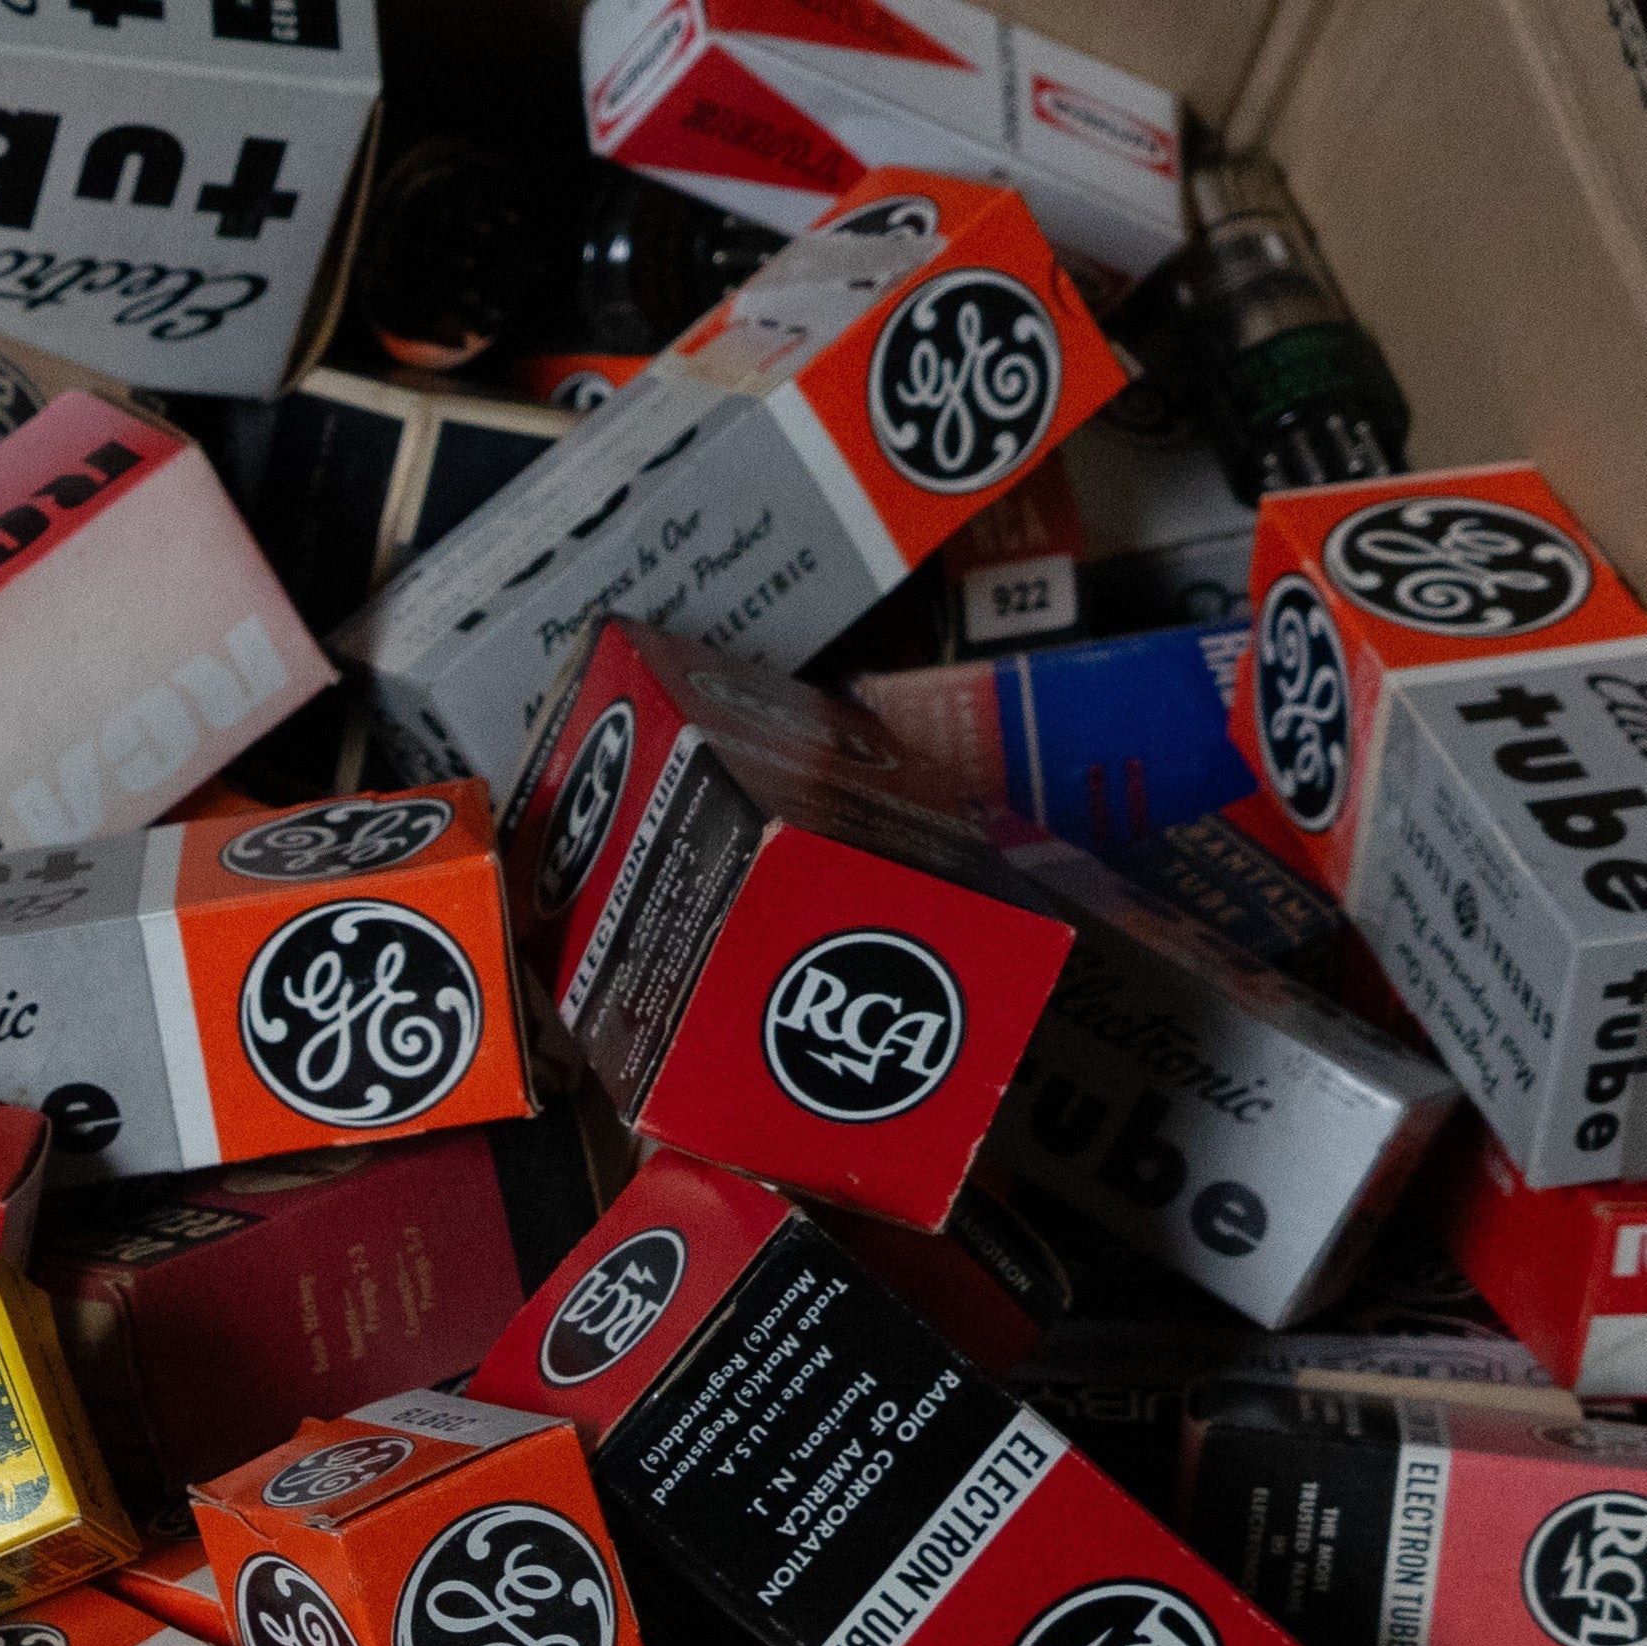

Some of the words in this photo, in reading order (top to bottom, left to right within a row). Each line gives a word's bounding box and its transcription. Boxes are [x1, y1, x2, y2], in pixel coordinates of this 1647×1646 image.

[663, 510, 699, 551] Our
[992, 578, 1051, 616] 922
[1457, 685, 1647, 914] tube
[567, 835, 650, 1017] ELECTRON
[650, 745, 694, 829] TUBE
[774, 965, 949, 1086] RCA
[741, 1268, 818, 1352] Marca(s)
[797, 1278, 850, 1334] Trade
[738, 1333, 803, 1411] Mark(s)
[779, 1345, 835, 1404] Made
[896, 1373, 962, 1443] RADIO
[638, 1355, 748, 1474] Registrada(s)
[711, 1423, 769, 1481] U.S.A.
[762, 1405, 785, 1428] in
[788, 1371, 879, 1463] Harrison,
[869, 1400, 899, 1437] OF
[652, 1409, 741, 1508] Registered
[765, 1469, 797, 1497] N.
[777, 1438, 867, 1538] AMERICA
[746, 1497, 770, 1518] J.
[756, 1449, 896, 1608] CORPORATION
[896, 1430, 1047, 1602] ELECTRON
[1394, 1461, 1440, 1591] ELECTRON
